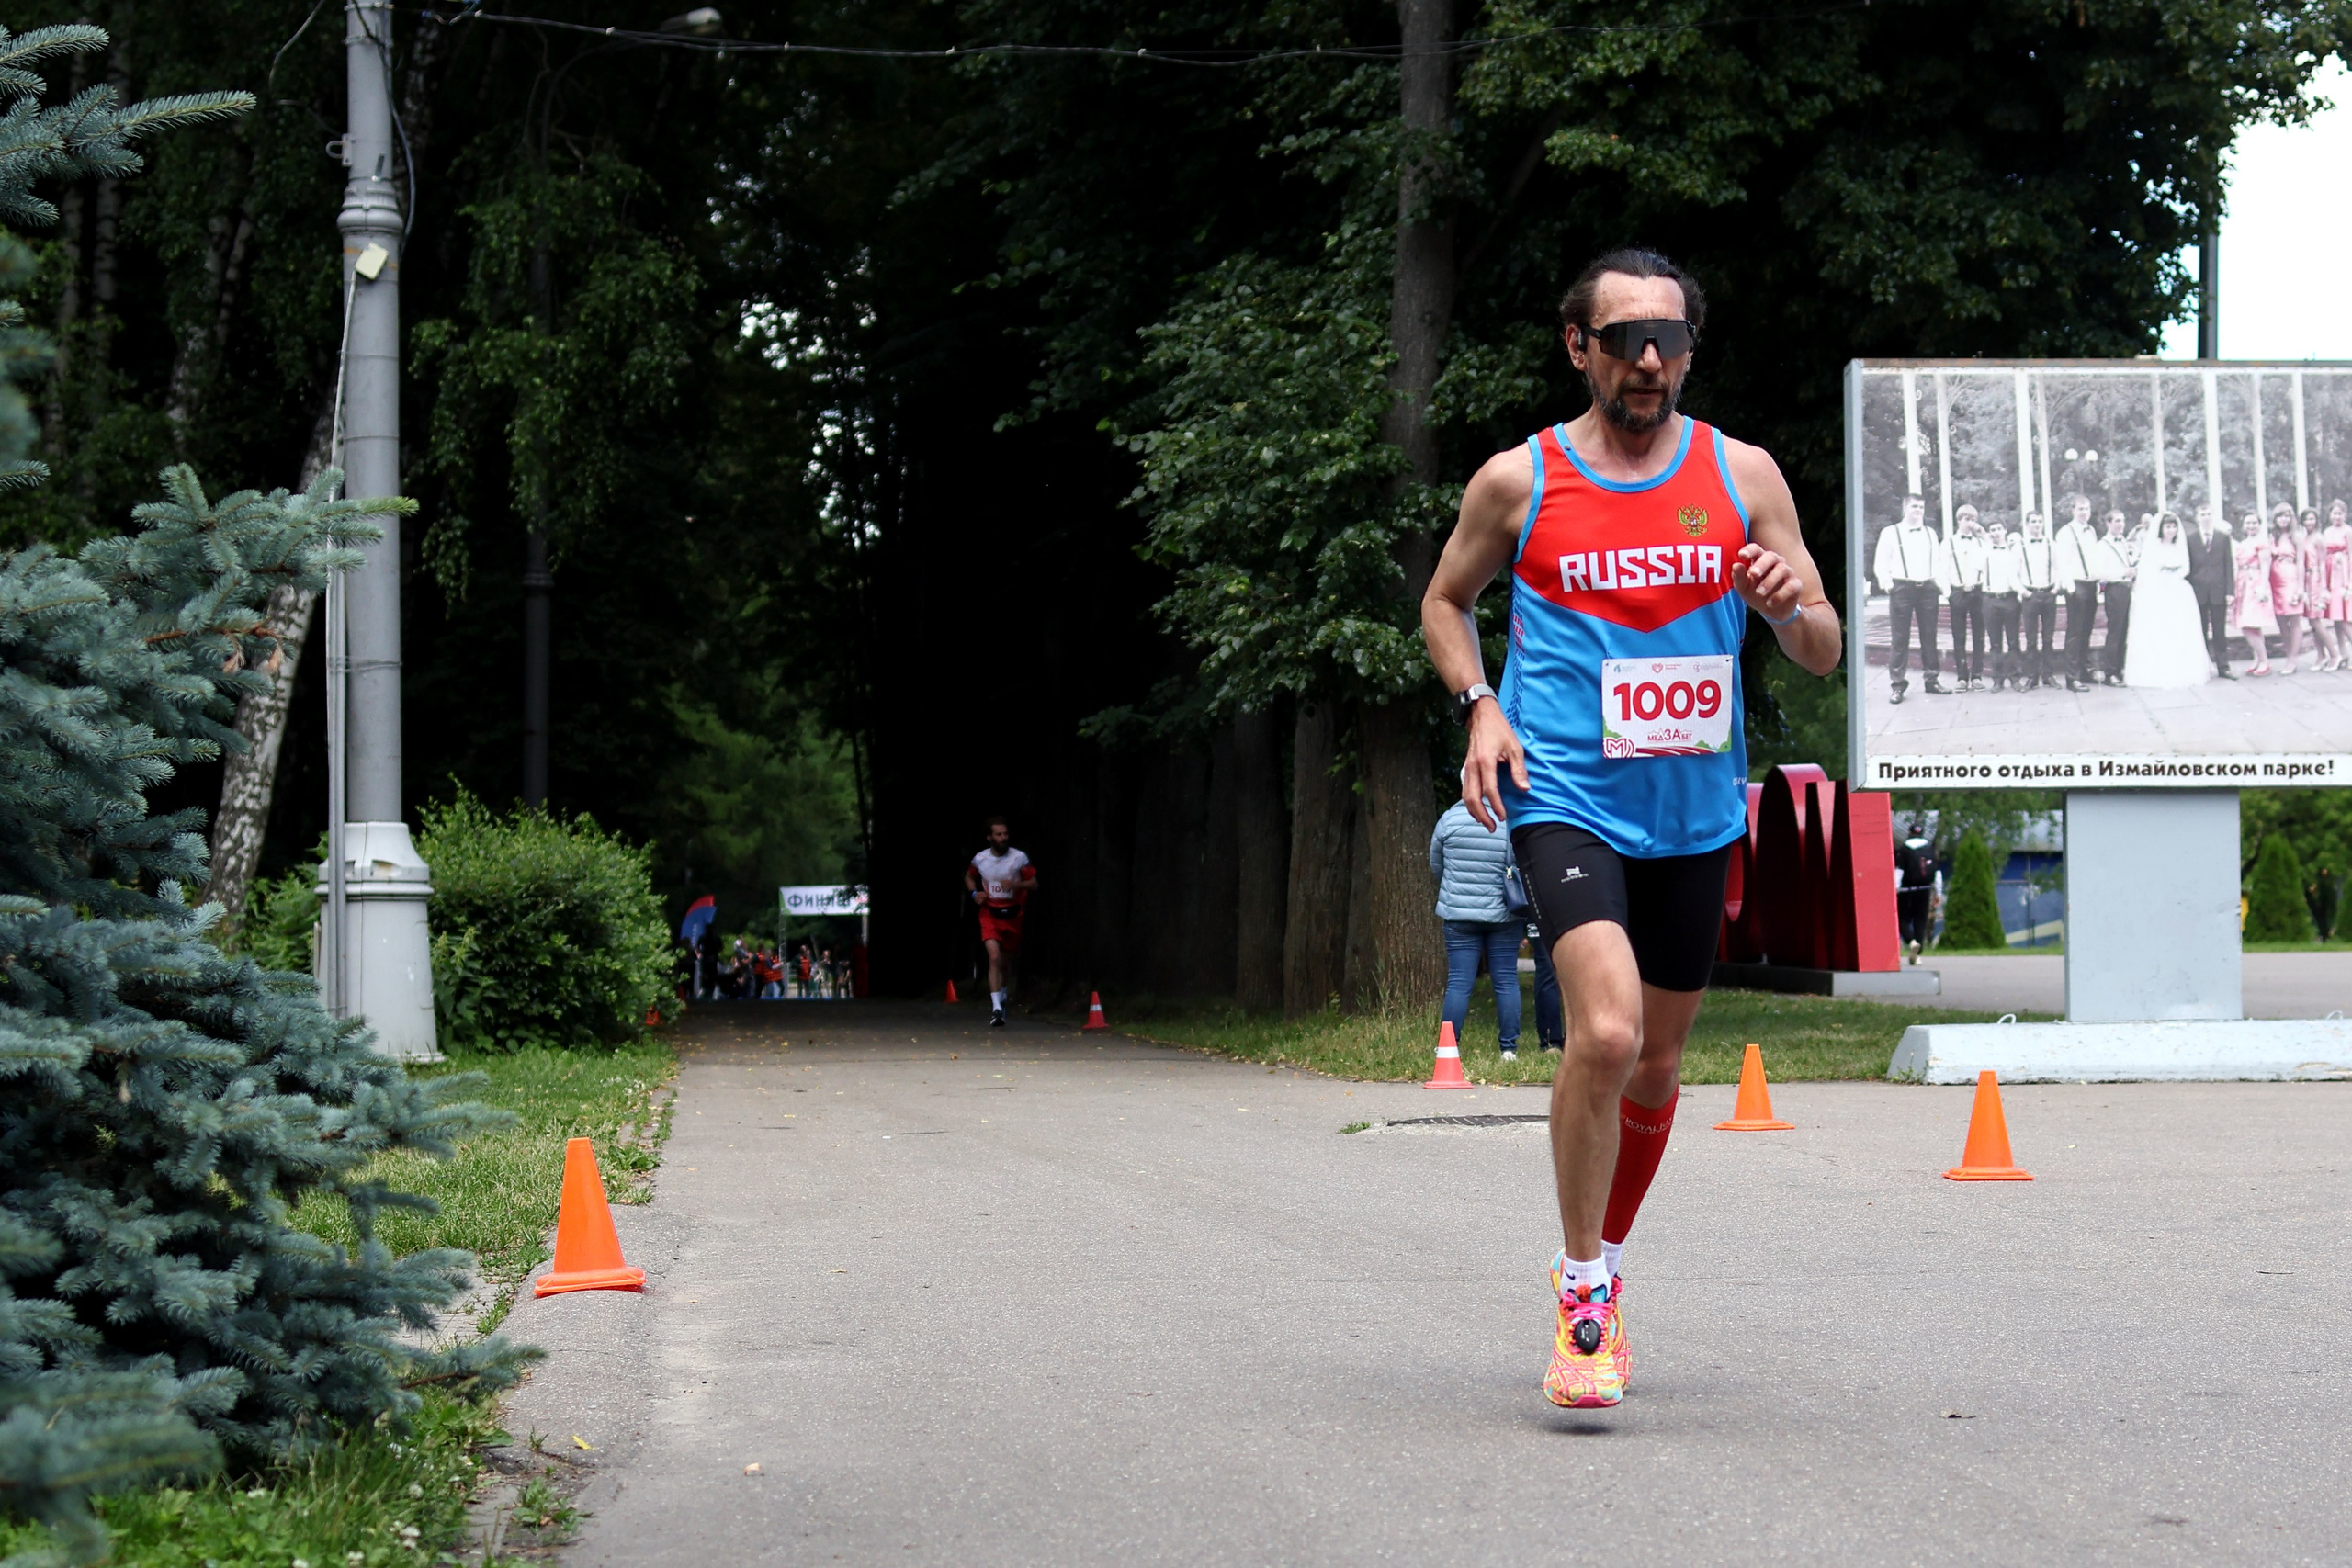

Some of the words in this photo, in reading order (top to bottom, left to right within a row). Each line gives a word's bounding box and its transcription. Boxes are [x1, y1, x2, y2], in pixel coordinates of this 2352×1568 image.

[1558, 545, 1722, 592] RUSSIA
[1613, 679, 1722, 721] 1009
[1879, 762, 1992, 782] Приятного
[1997, 764, 2075, 779] отдыха
[2081, 764, 2093, 776] в
[2098, 760, 2257, 777] Измайловском
[2263, 760, 2335, 778] парке!
[991, 885, 1012, 894] 10
[1625, 1115, 1673, 1132] ROYAL
